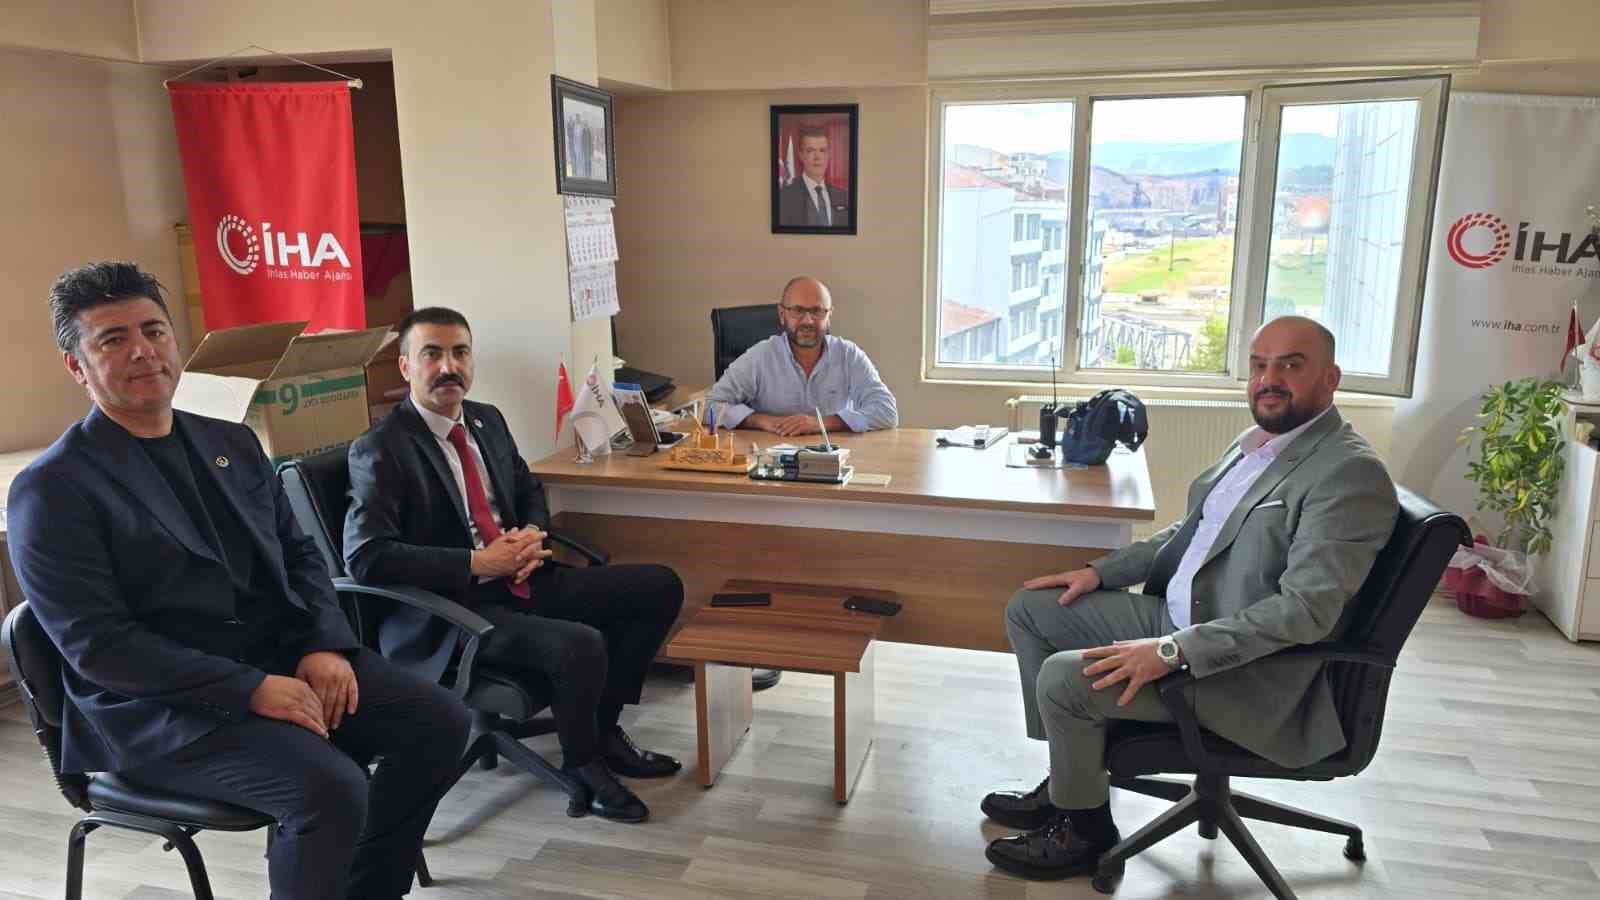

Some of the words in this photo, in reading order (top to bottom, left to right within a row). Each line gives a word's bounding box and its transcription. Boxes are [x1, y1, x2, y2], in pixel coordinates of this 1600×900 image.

[261, 222, 352, 268] İHA
[1514, 221, 1600, 264] İHA
[290, 269, 320, 280] Haber
[1471, 319, 1561, 334] www.iha.com.tr
